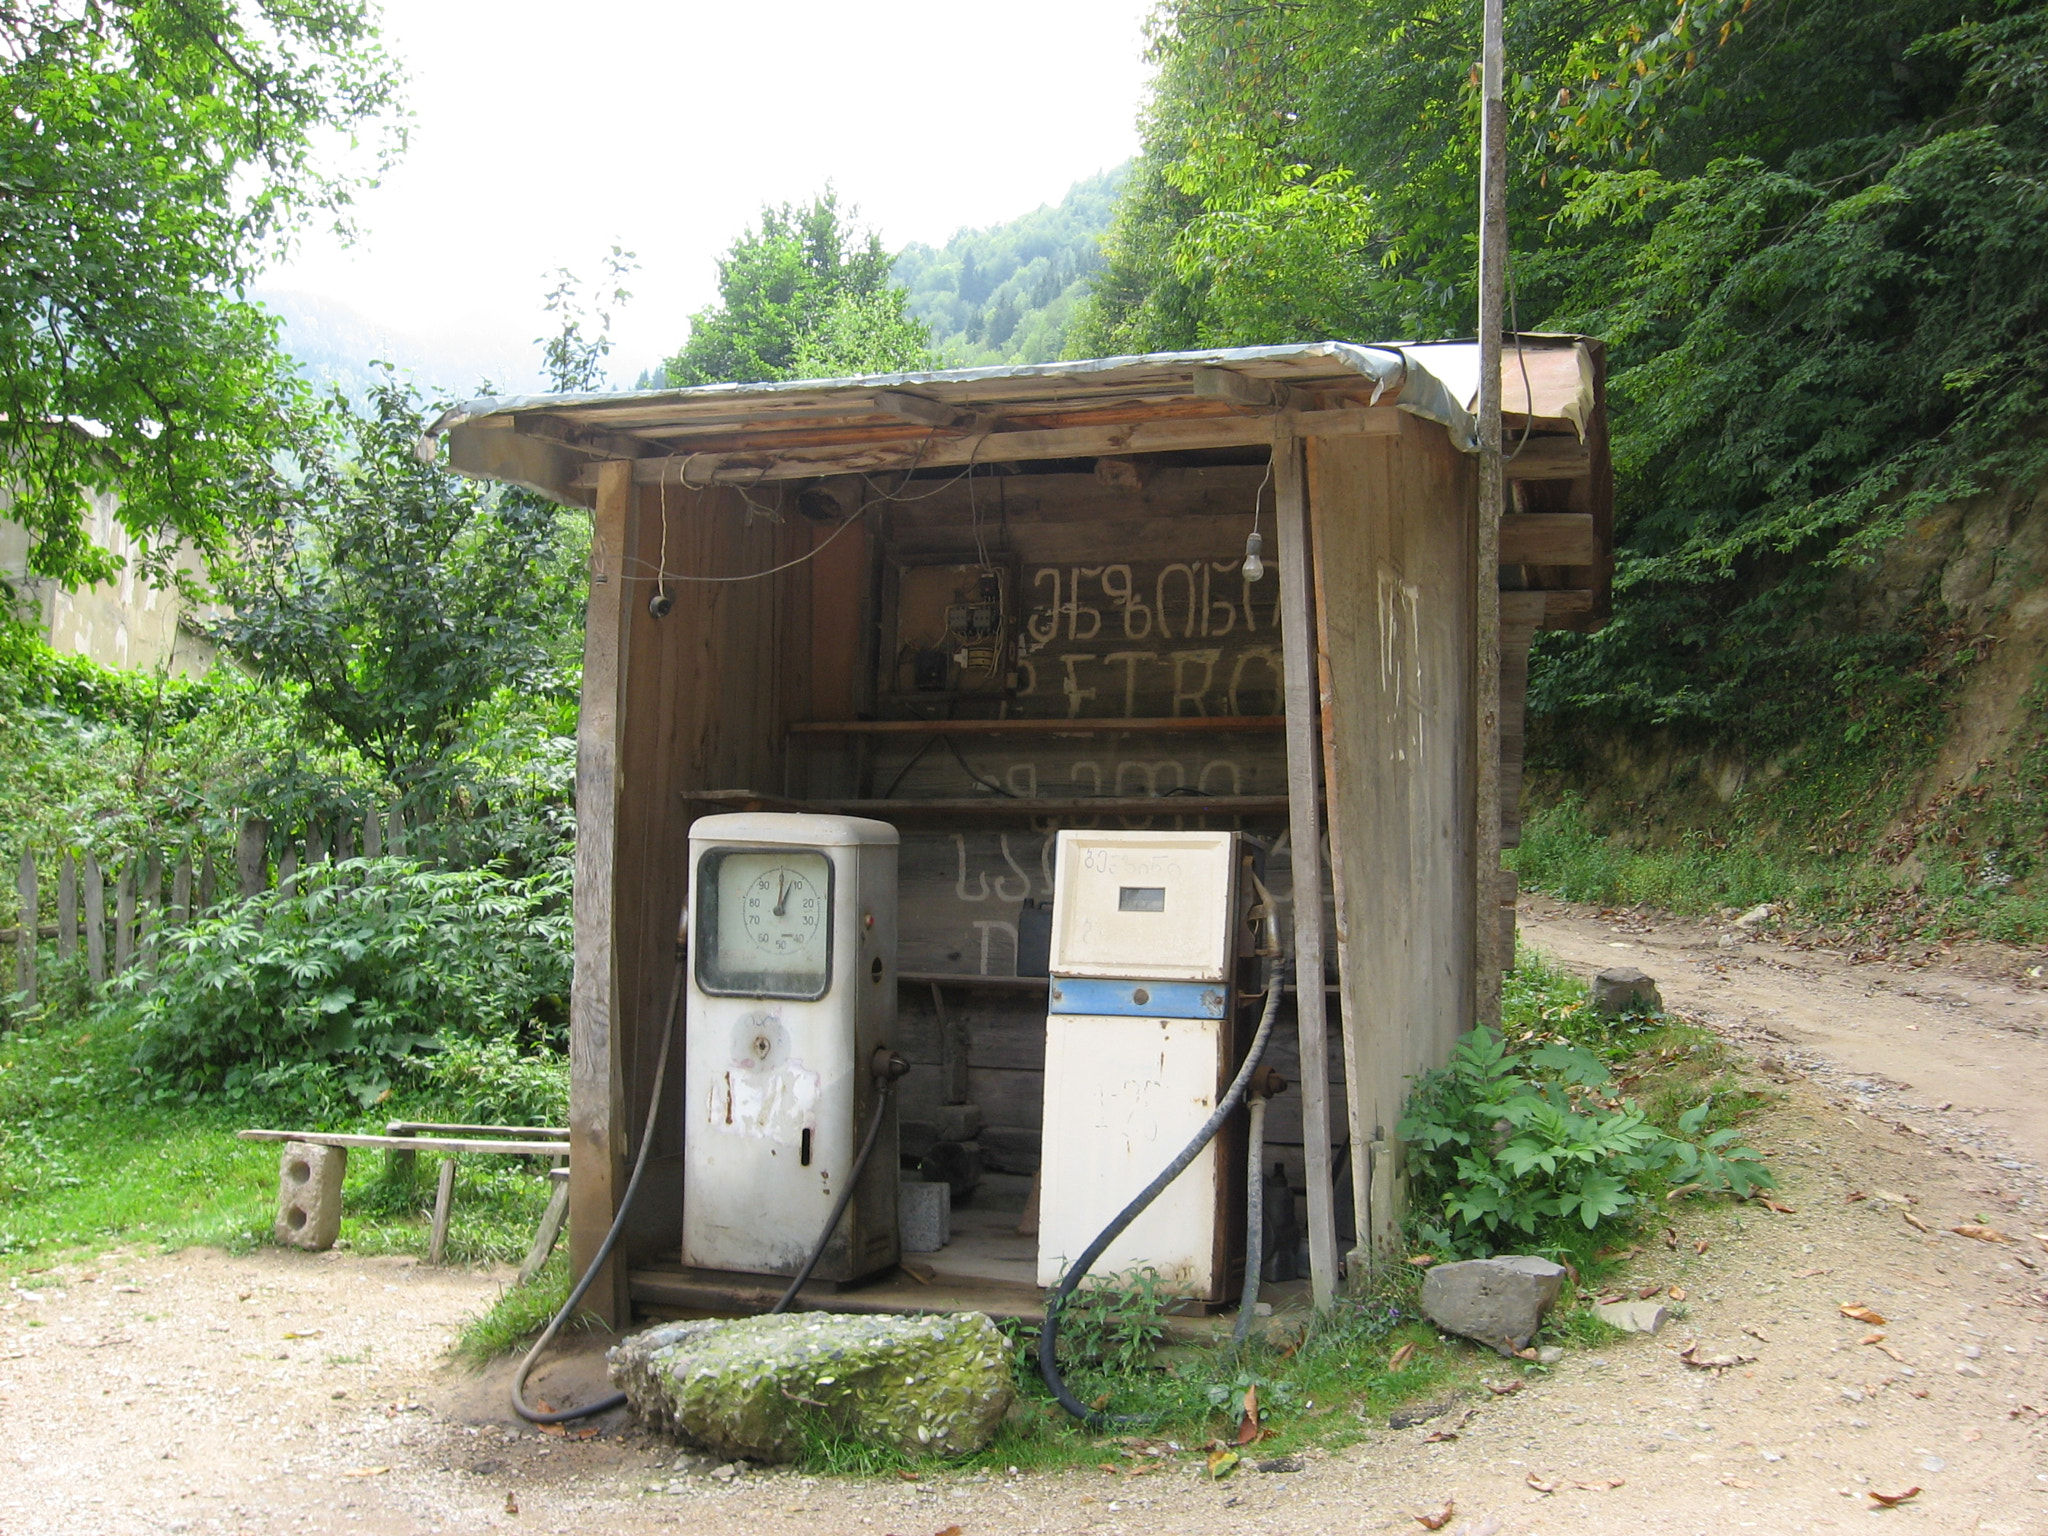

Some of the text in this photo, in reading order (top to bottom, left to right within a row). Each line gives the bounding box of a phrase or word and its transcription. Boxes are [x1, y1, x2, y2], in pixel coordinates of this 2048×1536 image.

[1027, 560, 1282, 642] ენზინი
[758, 880, 770, 890] 90
[793, 880, 803, 890] 10
[749, 898, 761, 907] 80
[802, 898, 814, 908] 20
[749, 915, 760, 925] 70
[802, 916, 814, 926] 30
[758, 933, 769, 943] 60
[775, 940, 787, 950] 50
